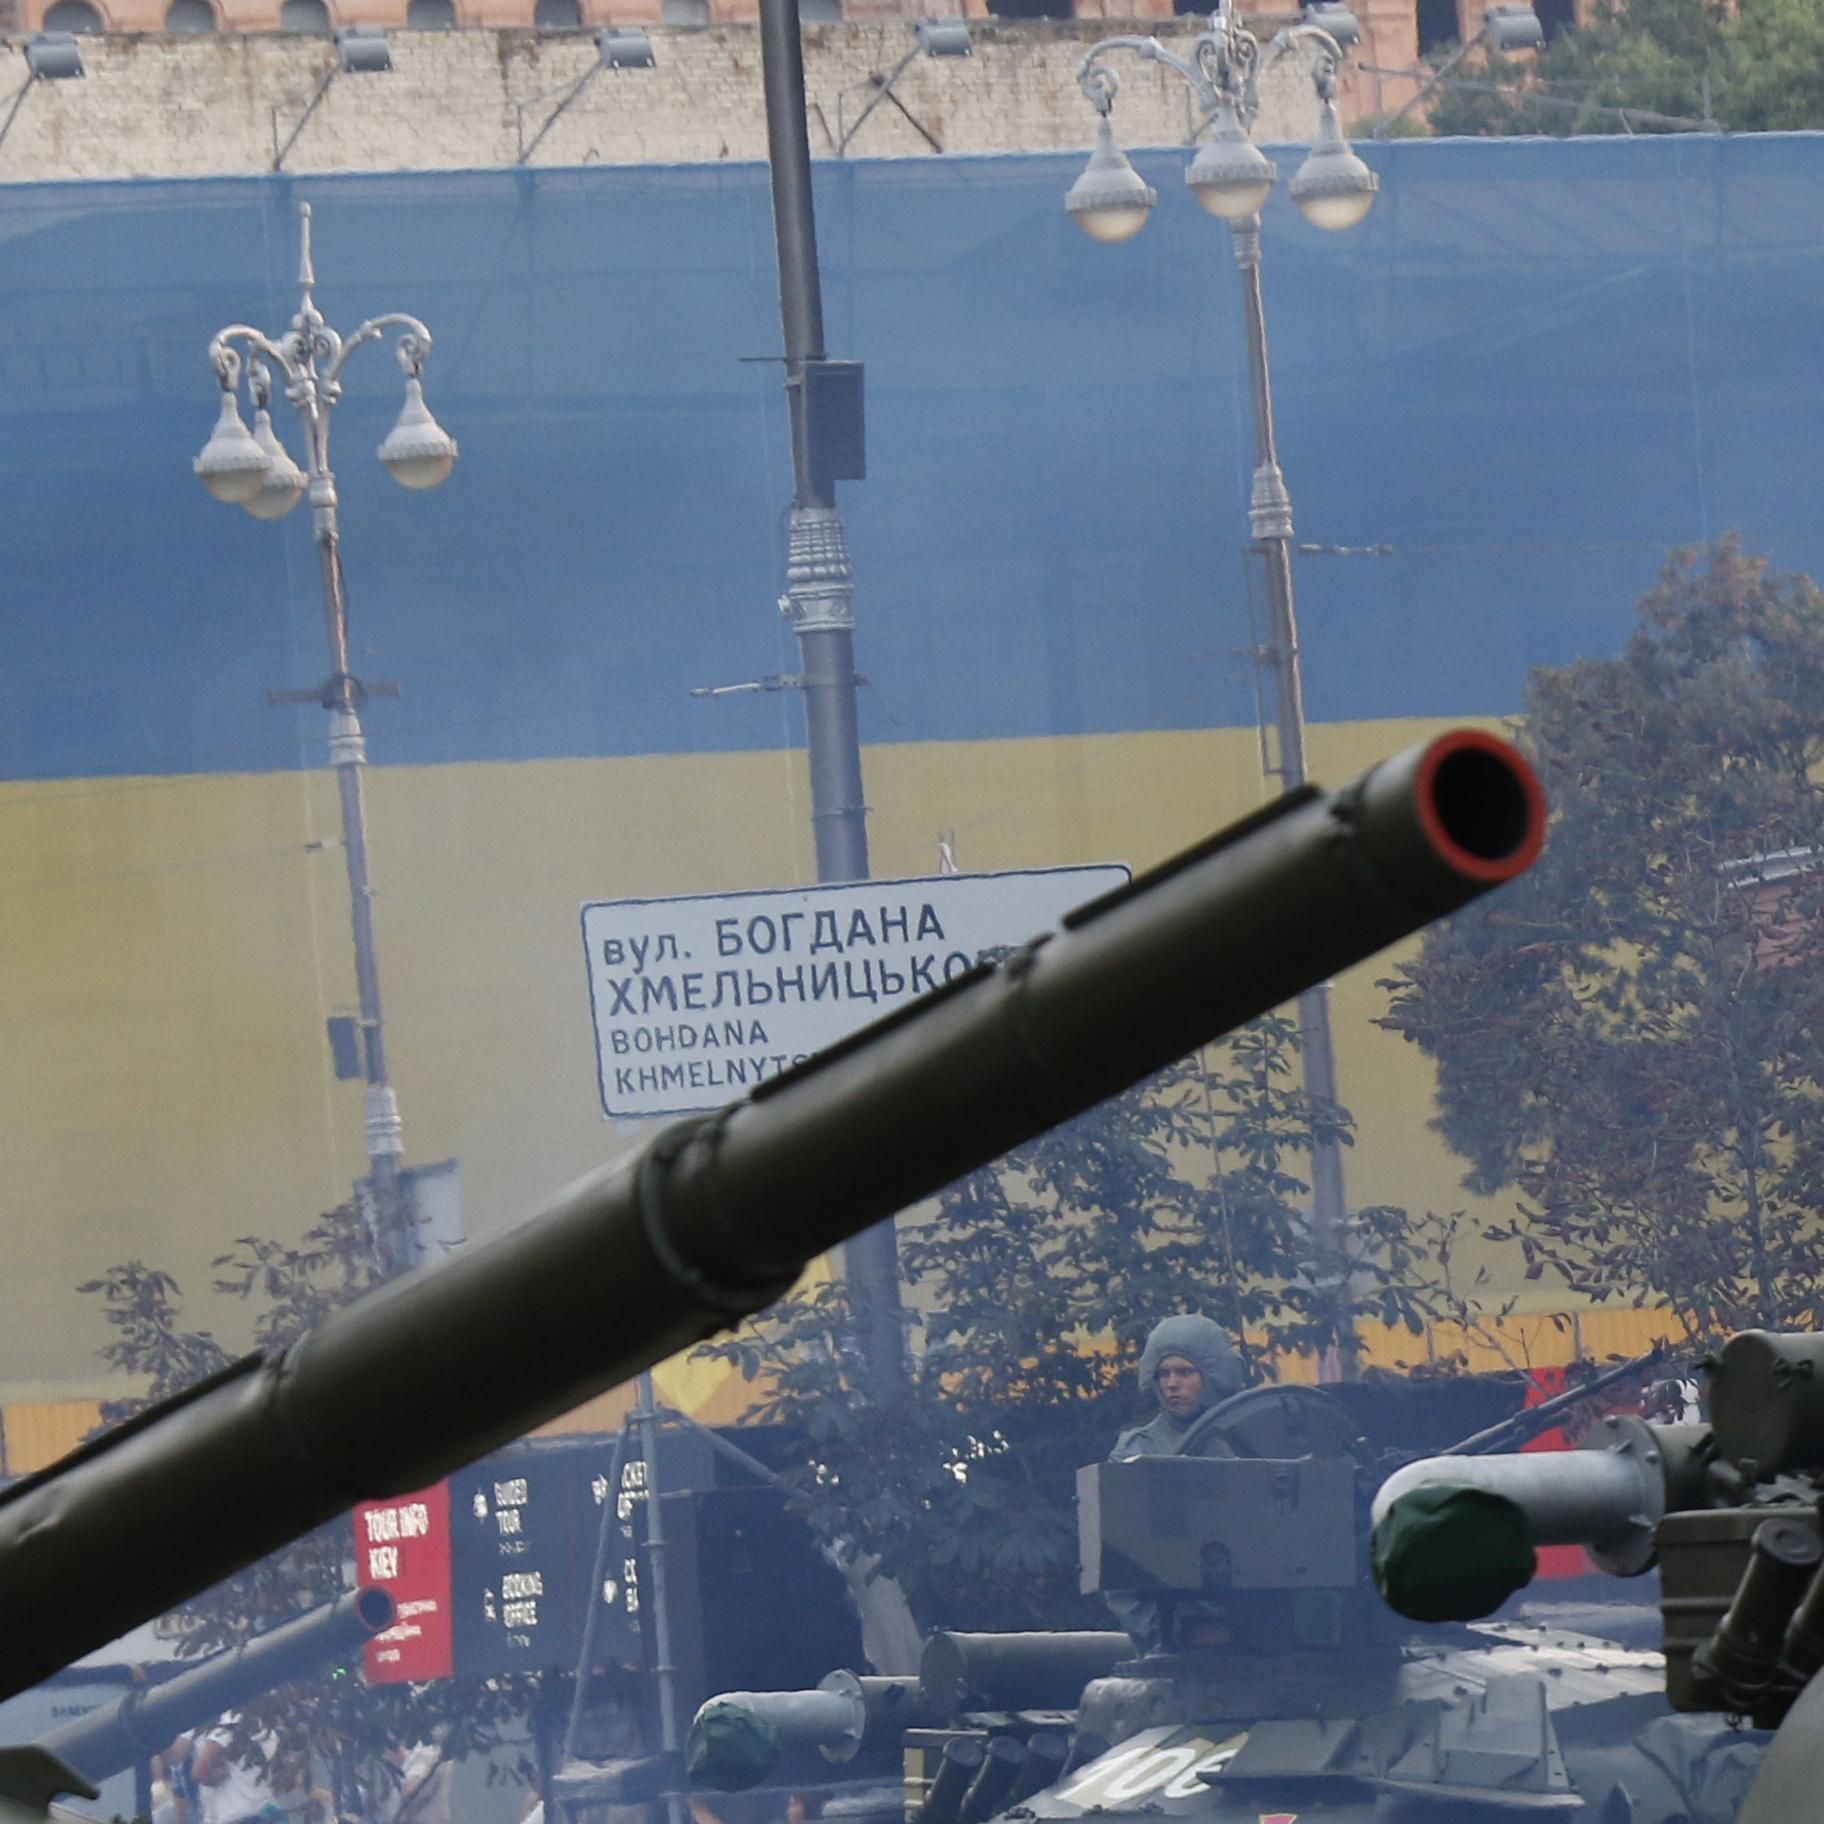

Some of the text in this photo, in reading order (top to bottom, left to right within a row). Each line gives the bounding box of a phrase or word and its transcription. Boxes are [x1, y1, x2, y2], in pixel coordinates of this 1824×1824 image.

[602, 903, 946, 973] вул. БОГДАНА
[607, 949, 1020, 1017] ХМЕЛЬНИЦЬКО
[611, 1020, 769, 1054] BOHDANA
